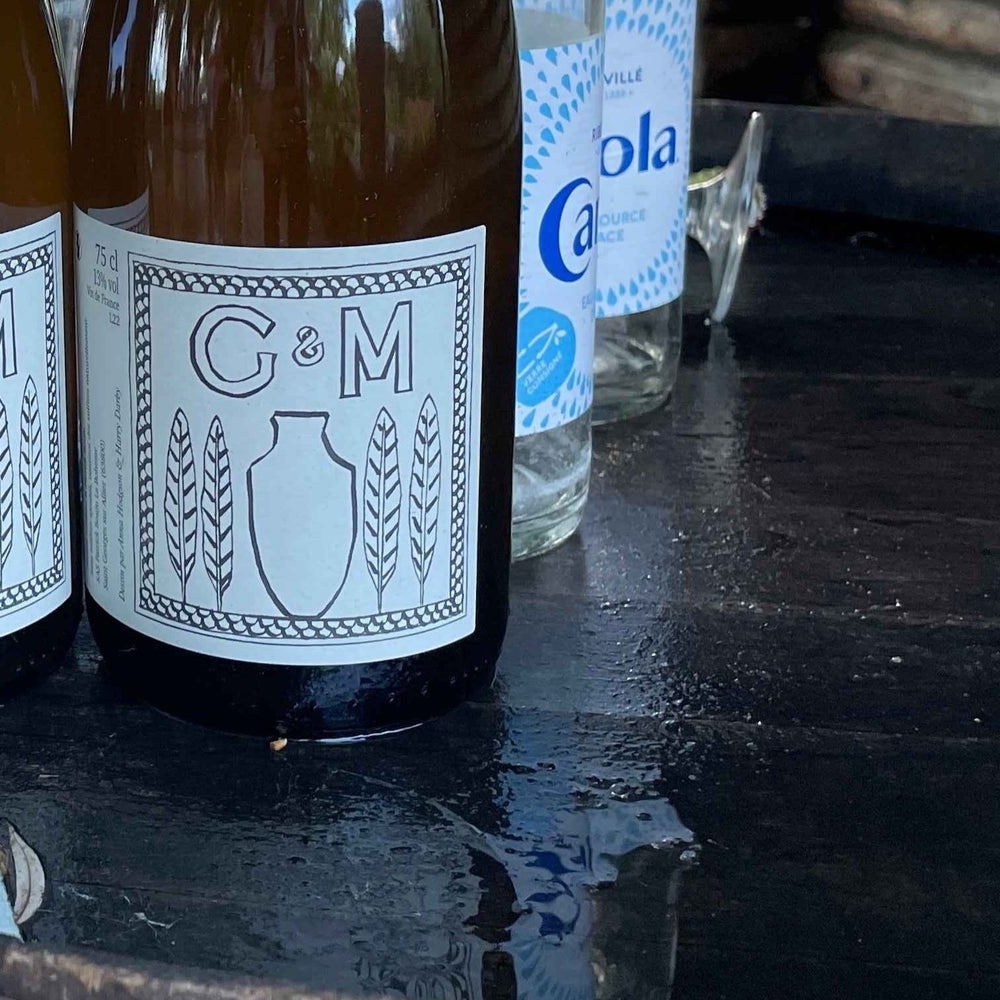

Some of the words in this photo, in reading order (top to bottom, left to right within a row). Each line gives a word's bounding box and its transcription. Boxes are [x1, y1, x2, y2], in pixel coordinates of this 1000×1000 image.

[600, 110, 677, 178] ola
[95, 243, 107, 267] 75
[109, 248, 119, 272] cl
[108, 276, 119, 295] vol
